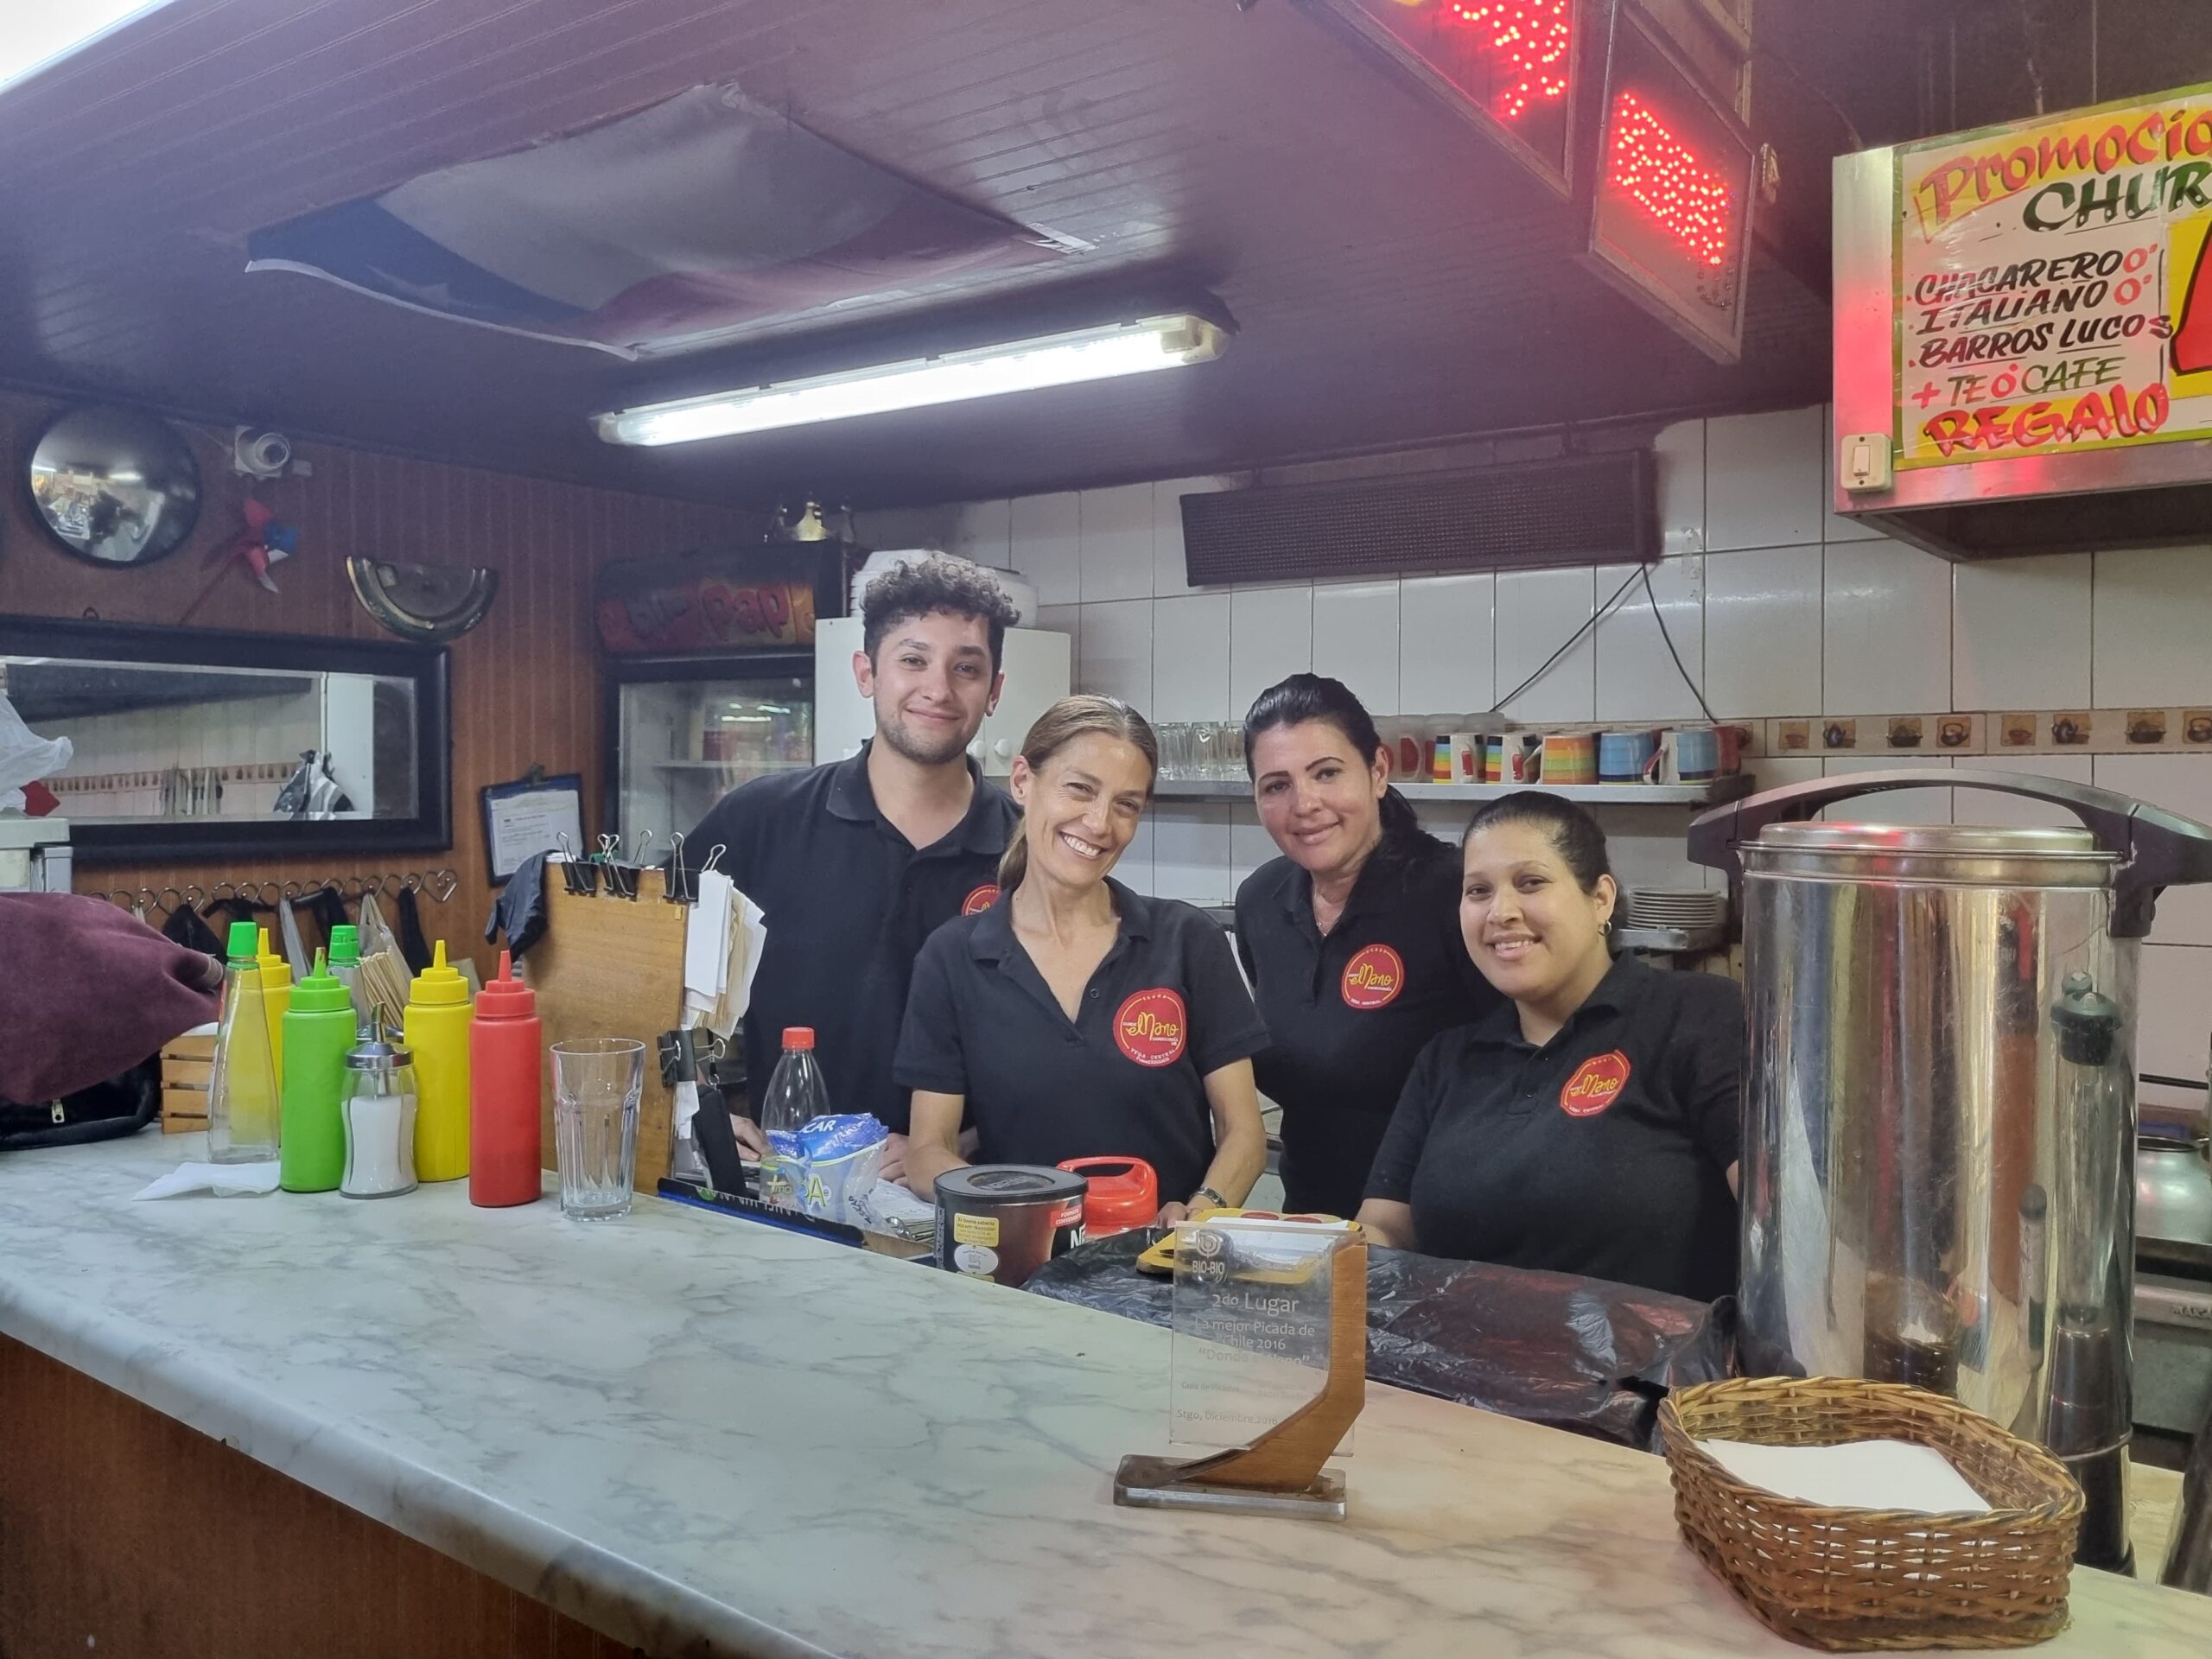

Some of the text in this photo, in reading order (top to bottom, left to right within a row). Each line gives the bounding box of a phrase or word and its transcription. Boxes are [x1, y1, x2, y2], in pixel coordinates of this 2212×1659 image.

[2023, 161, 2212, 232] CHUR
[1916, 280, 2108, 335] ITALIANO
[1919, 321, 2053, 368] BARROS
[1947, 374, 1988, 407] TE
[1211, 1292, 1300, 1317] 2do Lugar
[1195, 1317, 1315, 1337] La mejor Picada de
[1256, 1338, 1286, 1351] 2016
